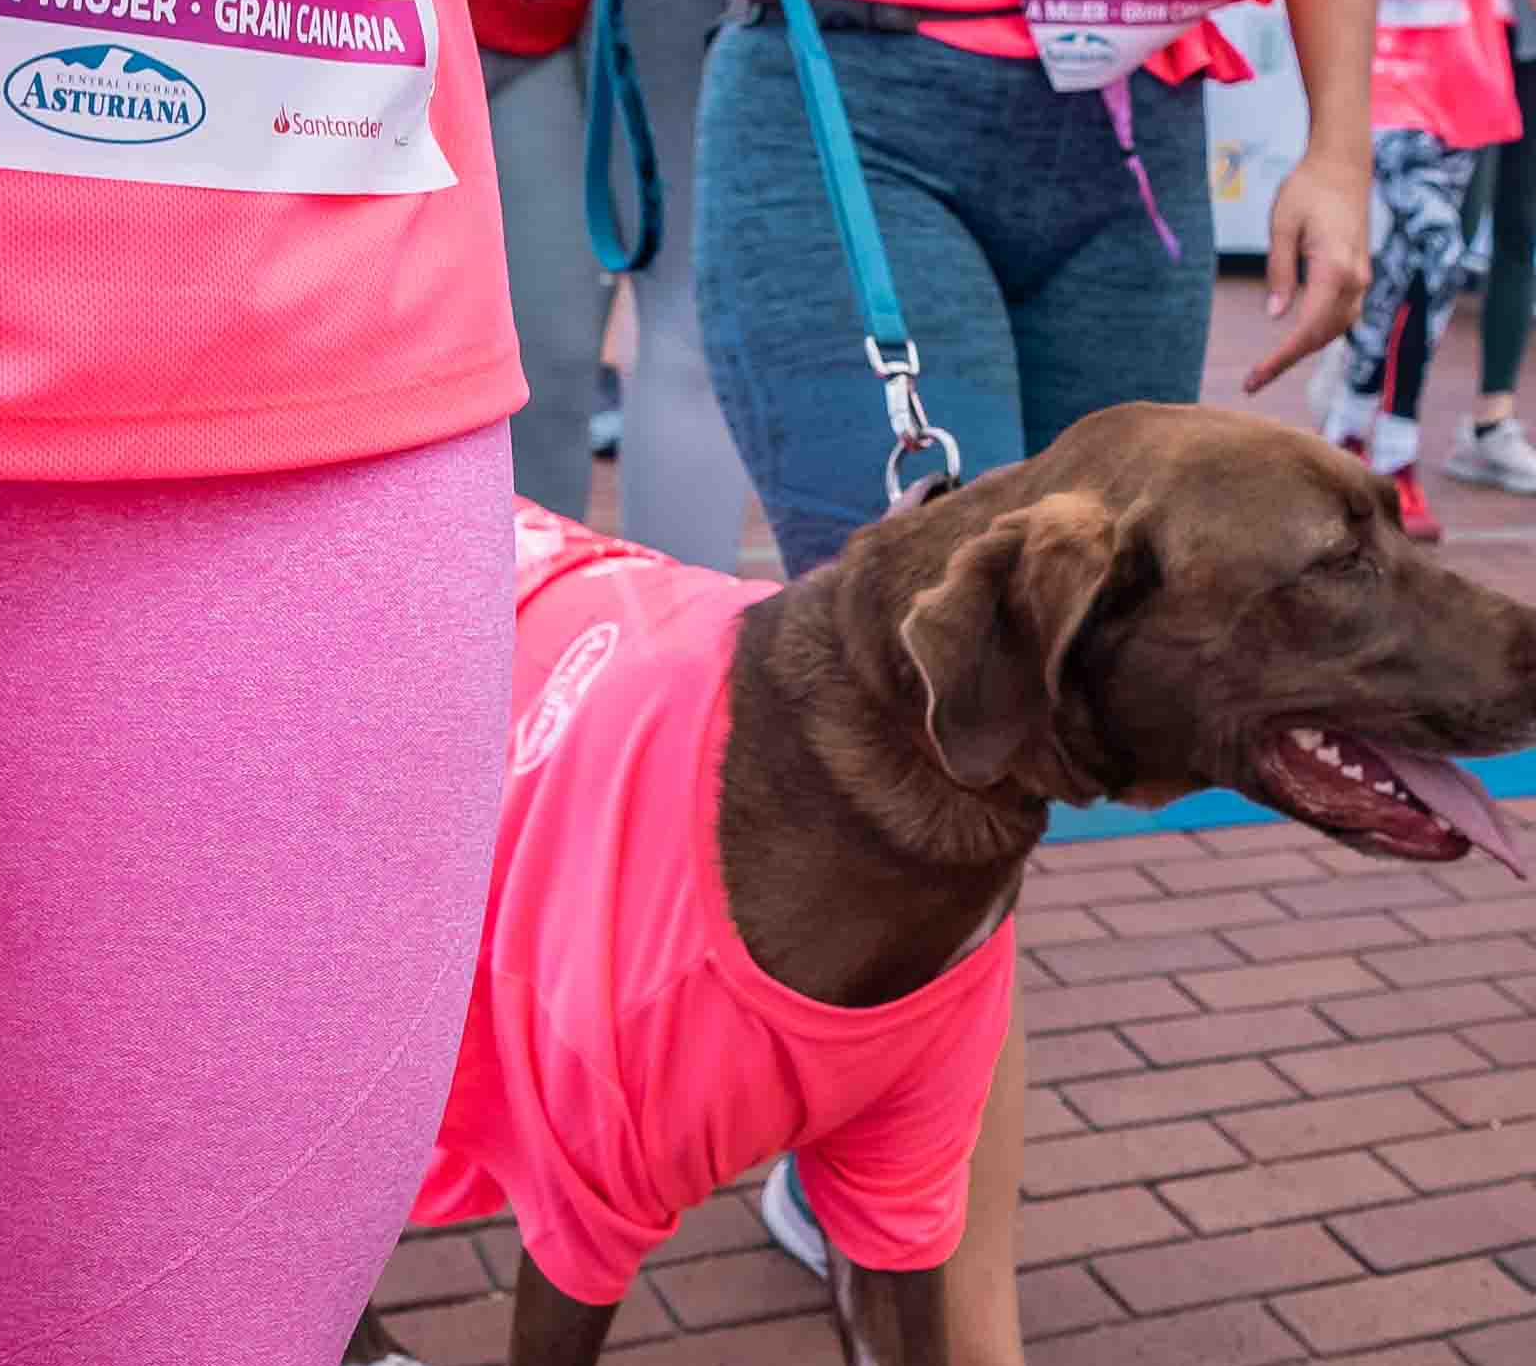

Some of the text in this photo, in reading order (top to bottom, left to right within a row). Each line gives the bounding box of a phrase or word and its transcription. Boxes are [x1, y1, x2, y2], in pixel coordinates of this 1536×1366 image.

[295, 7, 406, 54] CANARIA
[20, 71, 192, 125] ASTURIANA
[292, 112, 384, 139] Santander
